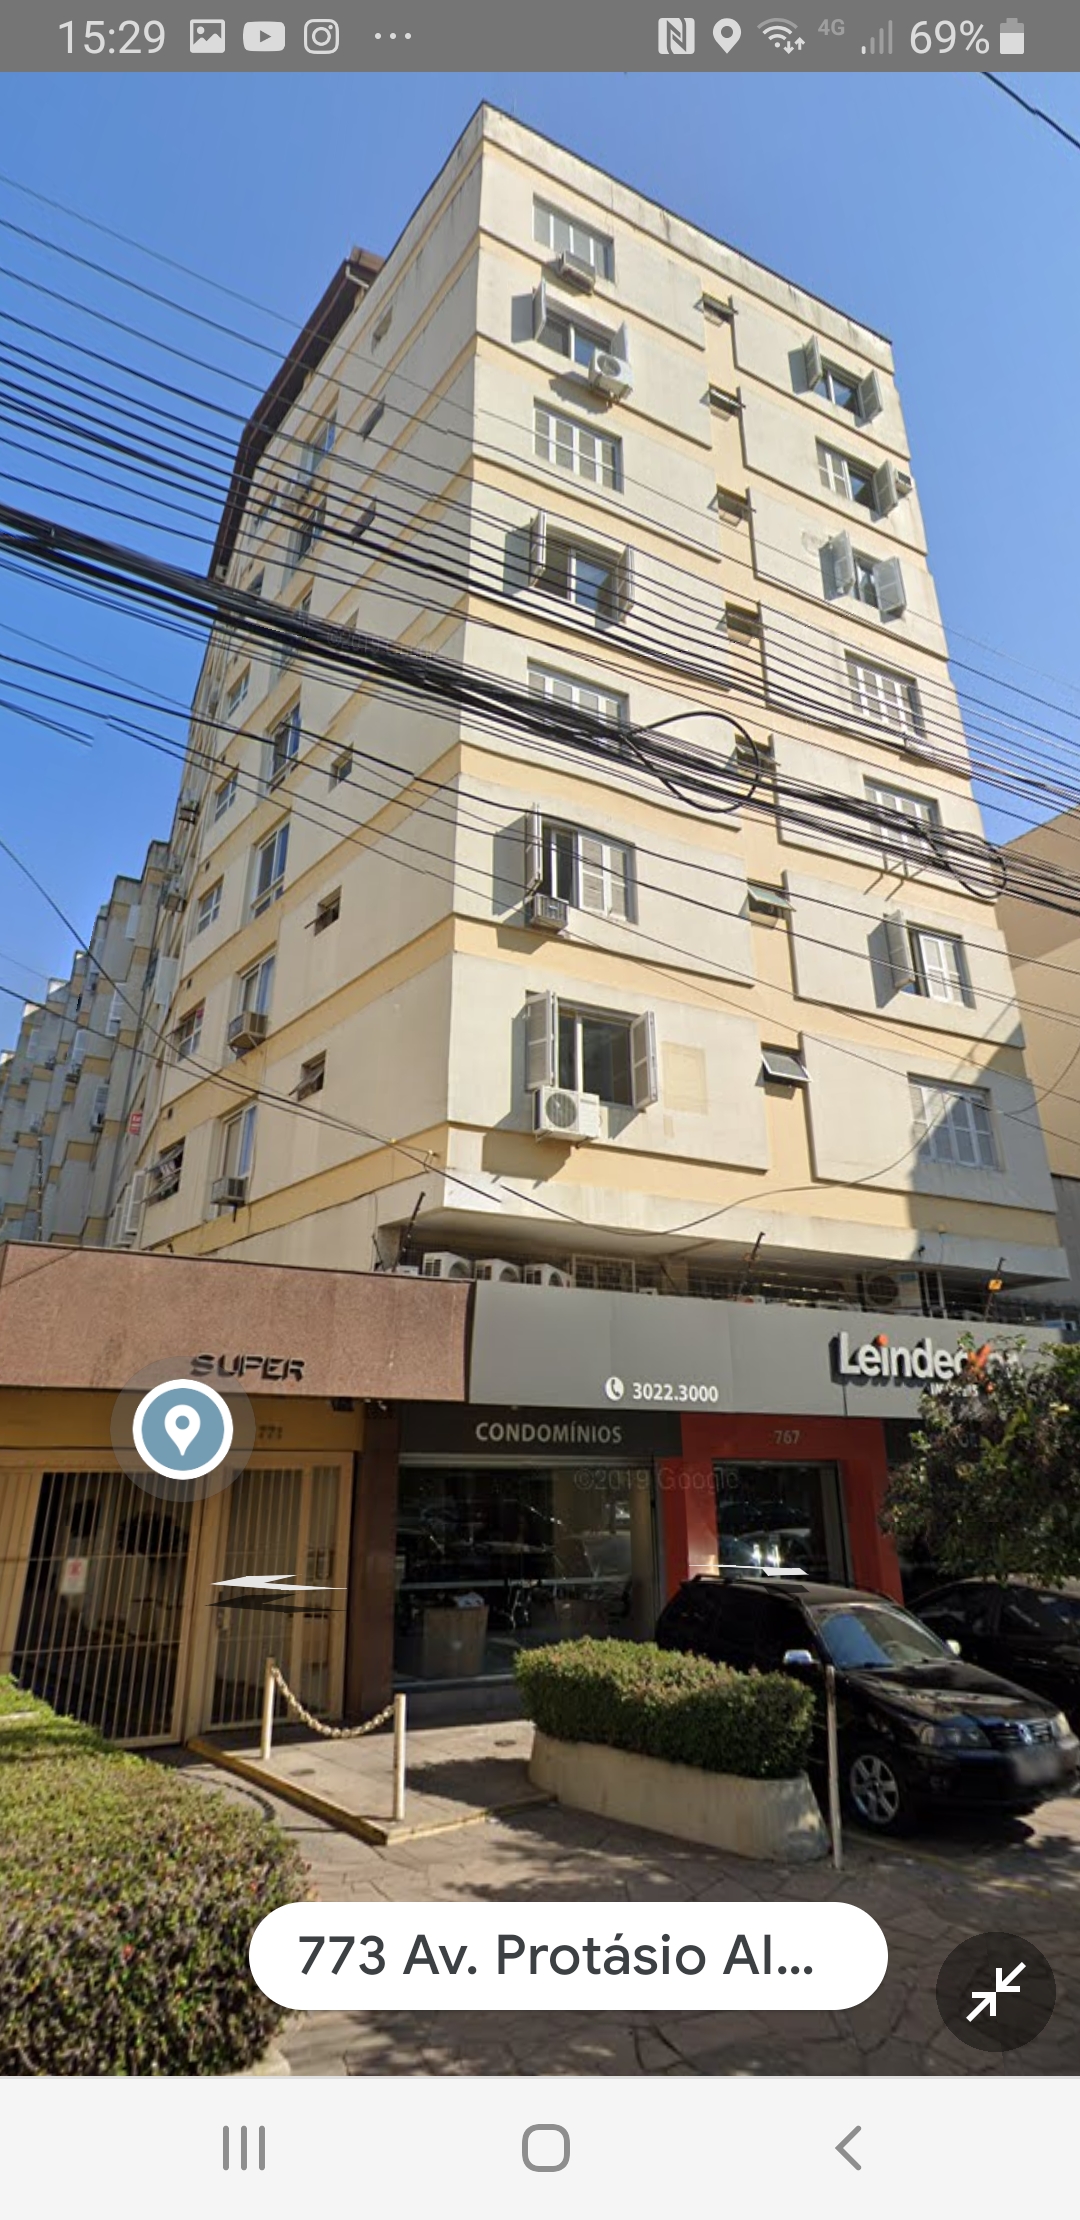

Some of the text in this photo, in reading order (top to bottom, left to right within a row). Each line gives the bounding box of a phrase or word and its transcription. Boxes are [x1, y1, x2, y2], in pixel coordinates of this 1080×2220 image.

[190, 1354, 305, 1382] SUPER
[632, 1382, 719, 1403] 3022.3000
[475, 1419, 622, 1444] CONDOMÍNIOS
[774, 1430, 801, 1445] 767
